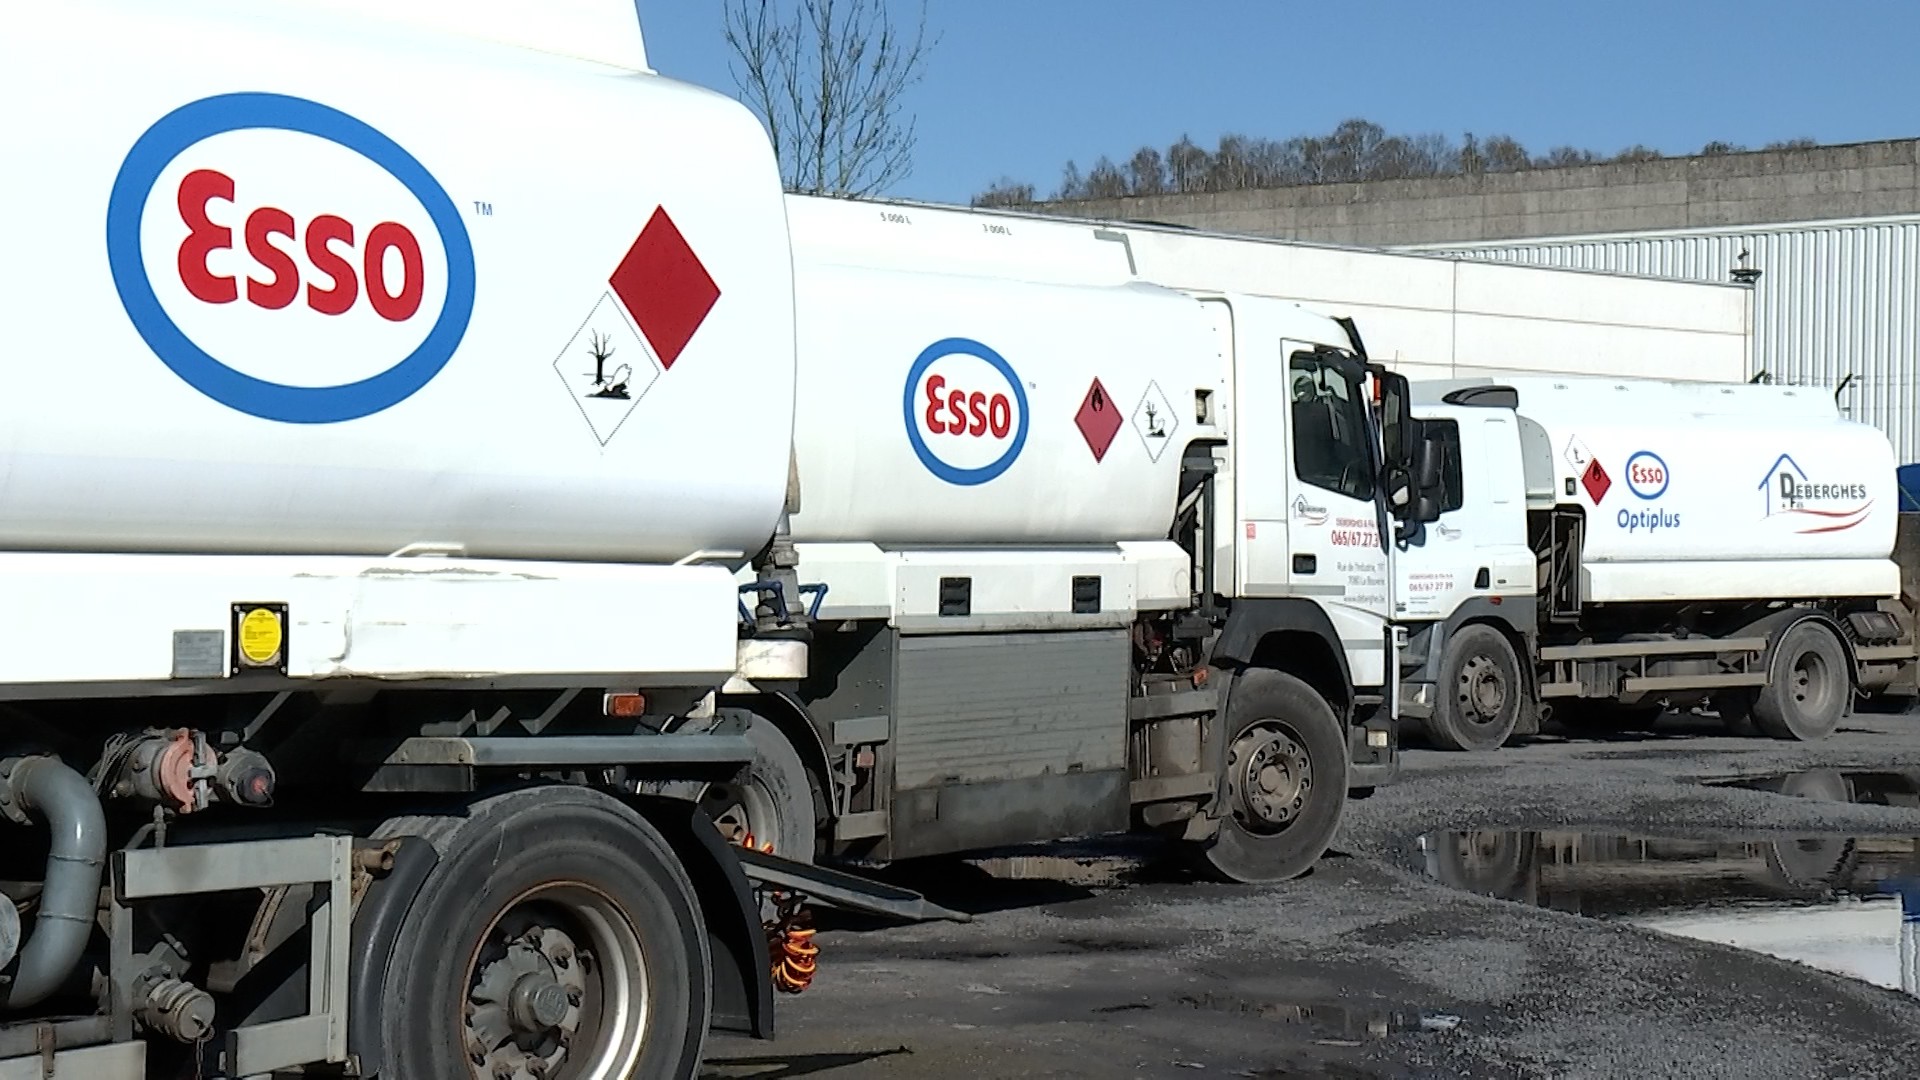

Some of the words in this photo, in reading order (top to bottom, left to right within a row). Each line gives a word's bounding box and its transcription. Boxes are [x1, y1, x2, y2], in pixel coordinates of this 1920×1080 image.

[473, 201, 493, 216] TM
[1780, 473, 1867, 500] DEBERGHES
[1617, 507, 1681, 534] Optiplus
